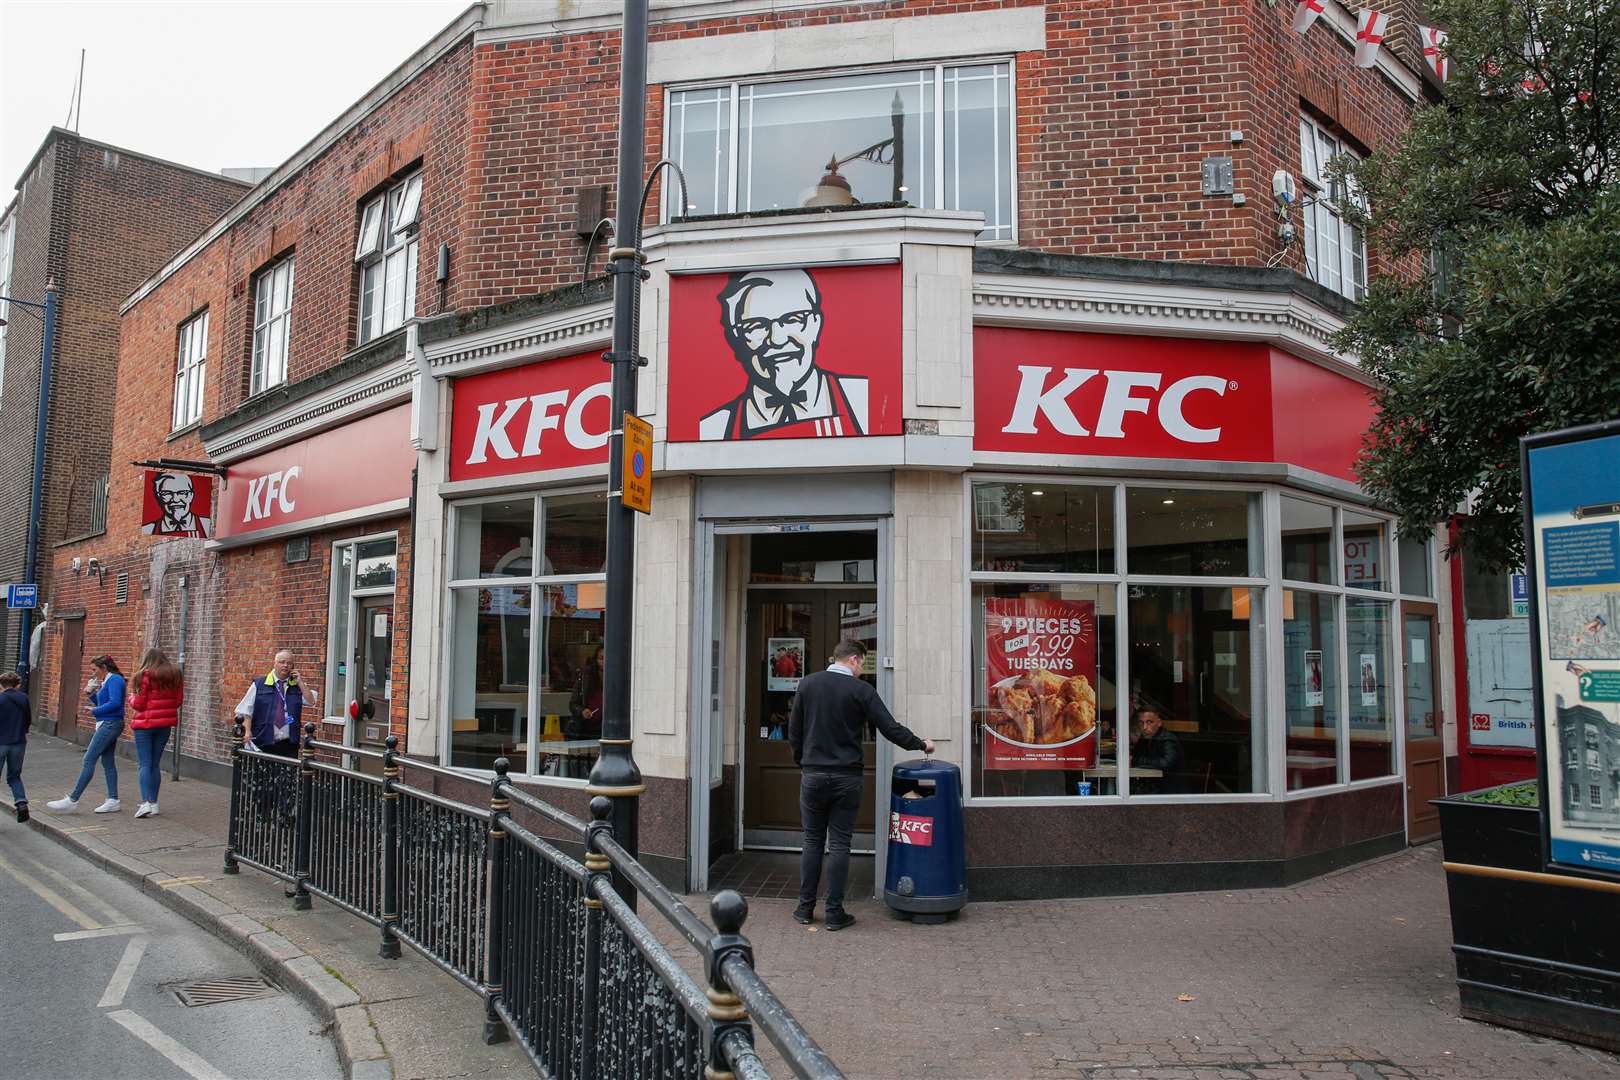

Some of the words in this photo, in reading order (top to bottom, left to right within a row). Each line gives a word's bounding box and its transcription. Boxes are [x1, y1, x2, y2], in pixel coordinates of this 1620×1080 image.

[1001, 365, 1228, 443] KFC
[465, 381, 612, 465] KFC
[242, 465, 300, 523] KFC
[1001, 618, 1013, 634] 9
[1015, 618, 1081, 635] PIECES
[1009, 638, 1024, 649] FOR
[1027, 634, 1075, 657] 5.99
[1007, 657, 1073, 670] TUESDAYS
[1498, 720, 1527, 729] British
[901, 820, 931, 834] KFC
